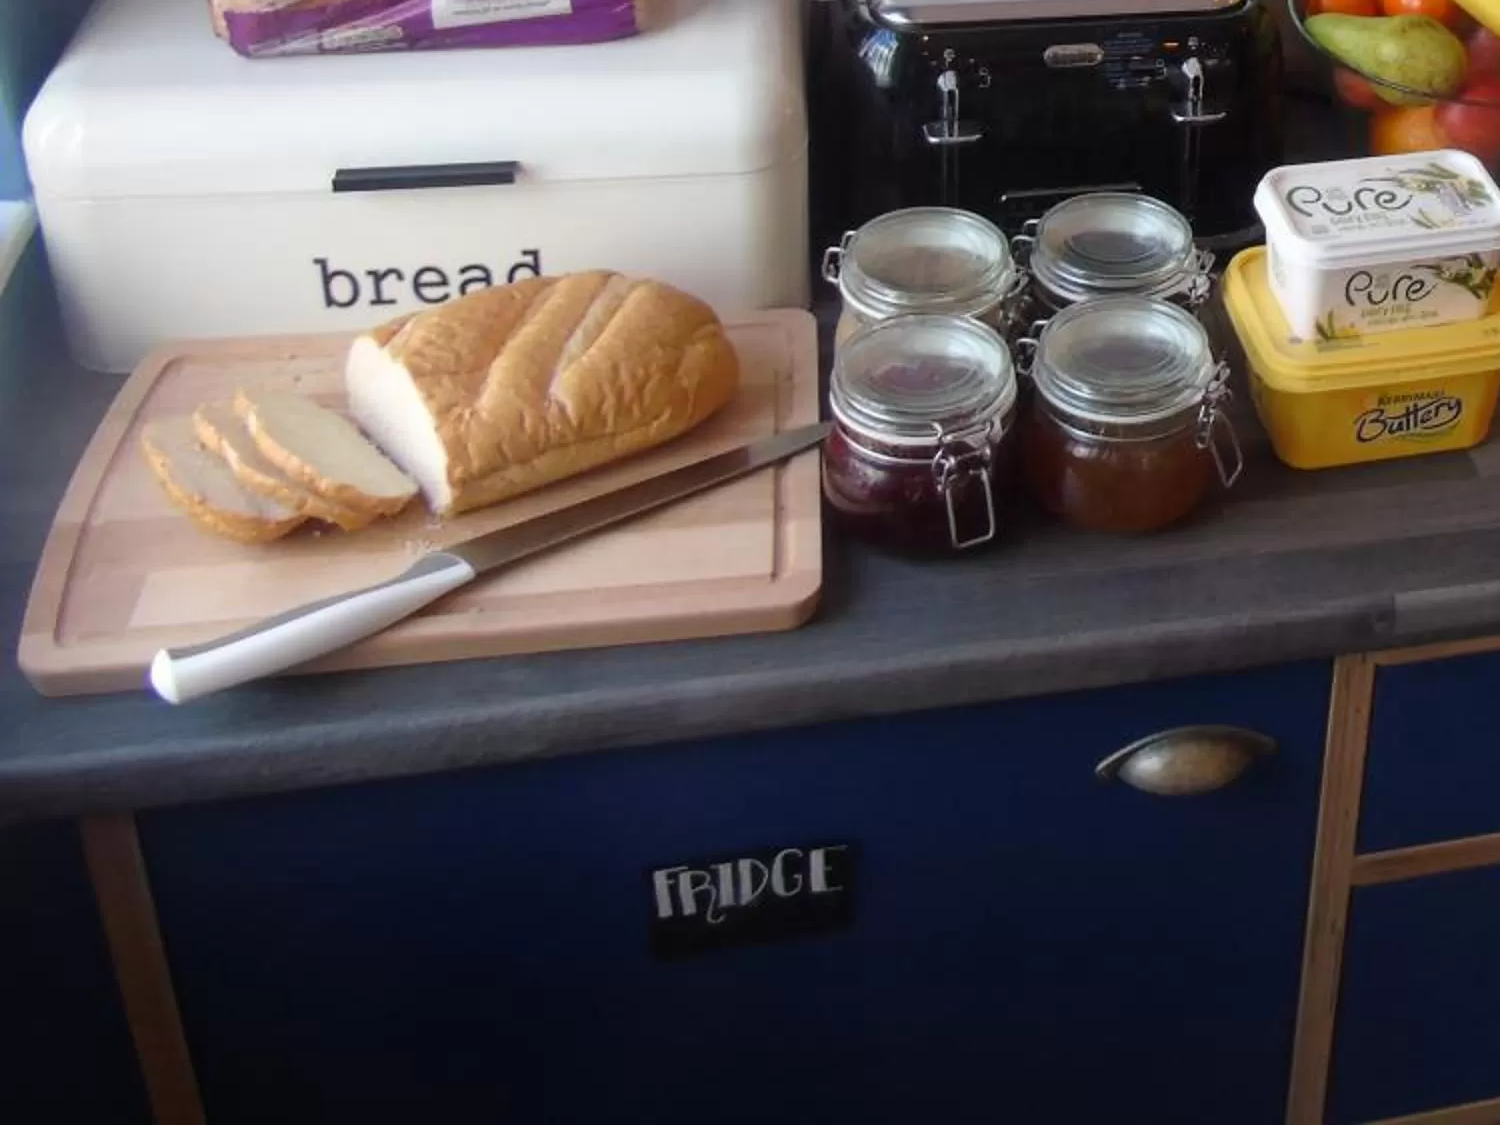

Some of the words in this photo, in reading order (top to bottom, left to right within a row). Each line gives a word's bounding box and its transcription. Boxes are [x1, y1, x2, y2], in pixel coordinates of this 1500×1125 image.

[1286, 186, 1413, 217] Pure
[1345, 271, 1438, 306] Pure
[1352, 397, 1462, 443] Buttery
[653, 845, 848, 923] FRIDGE
